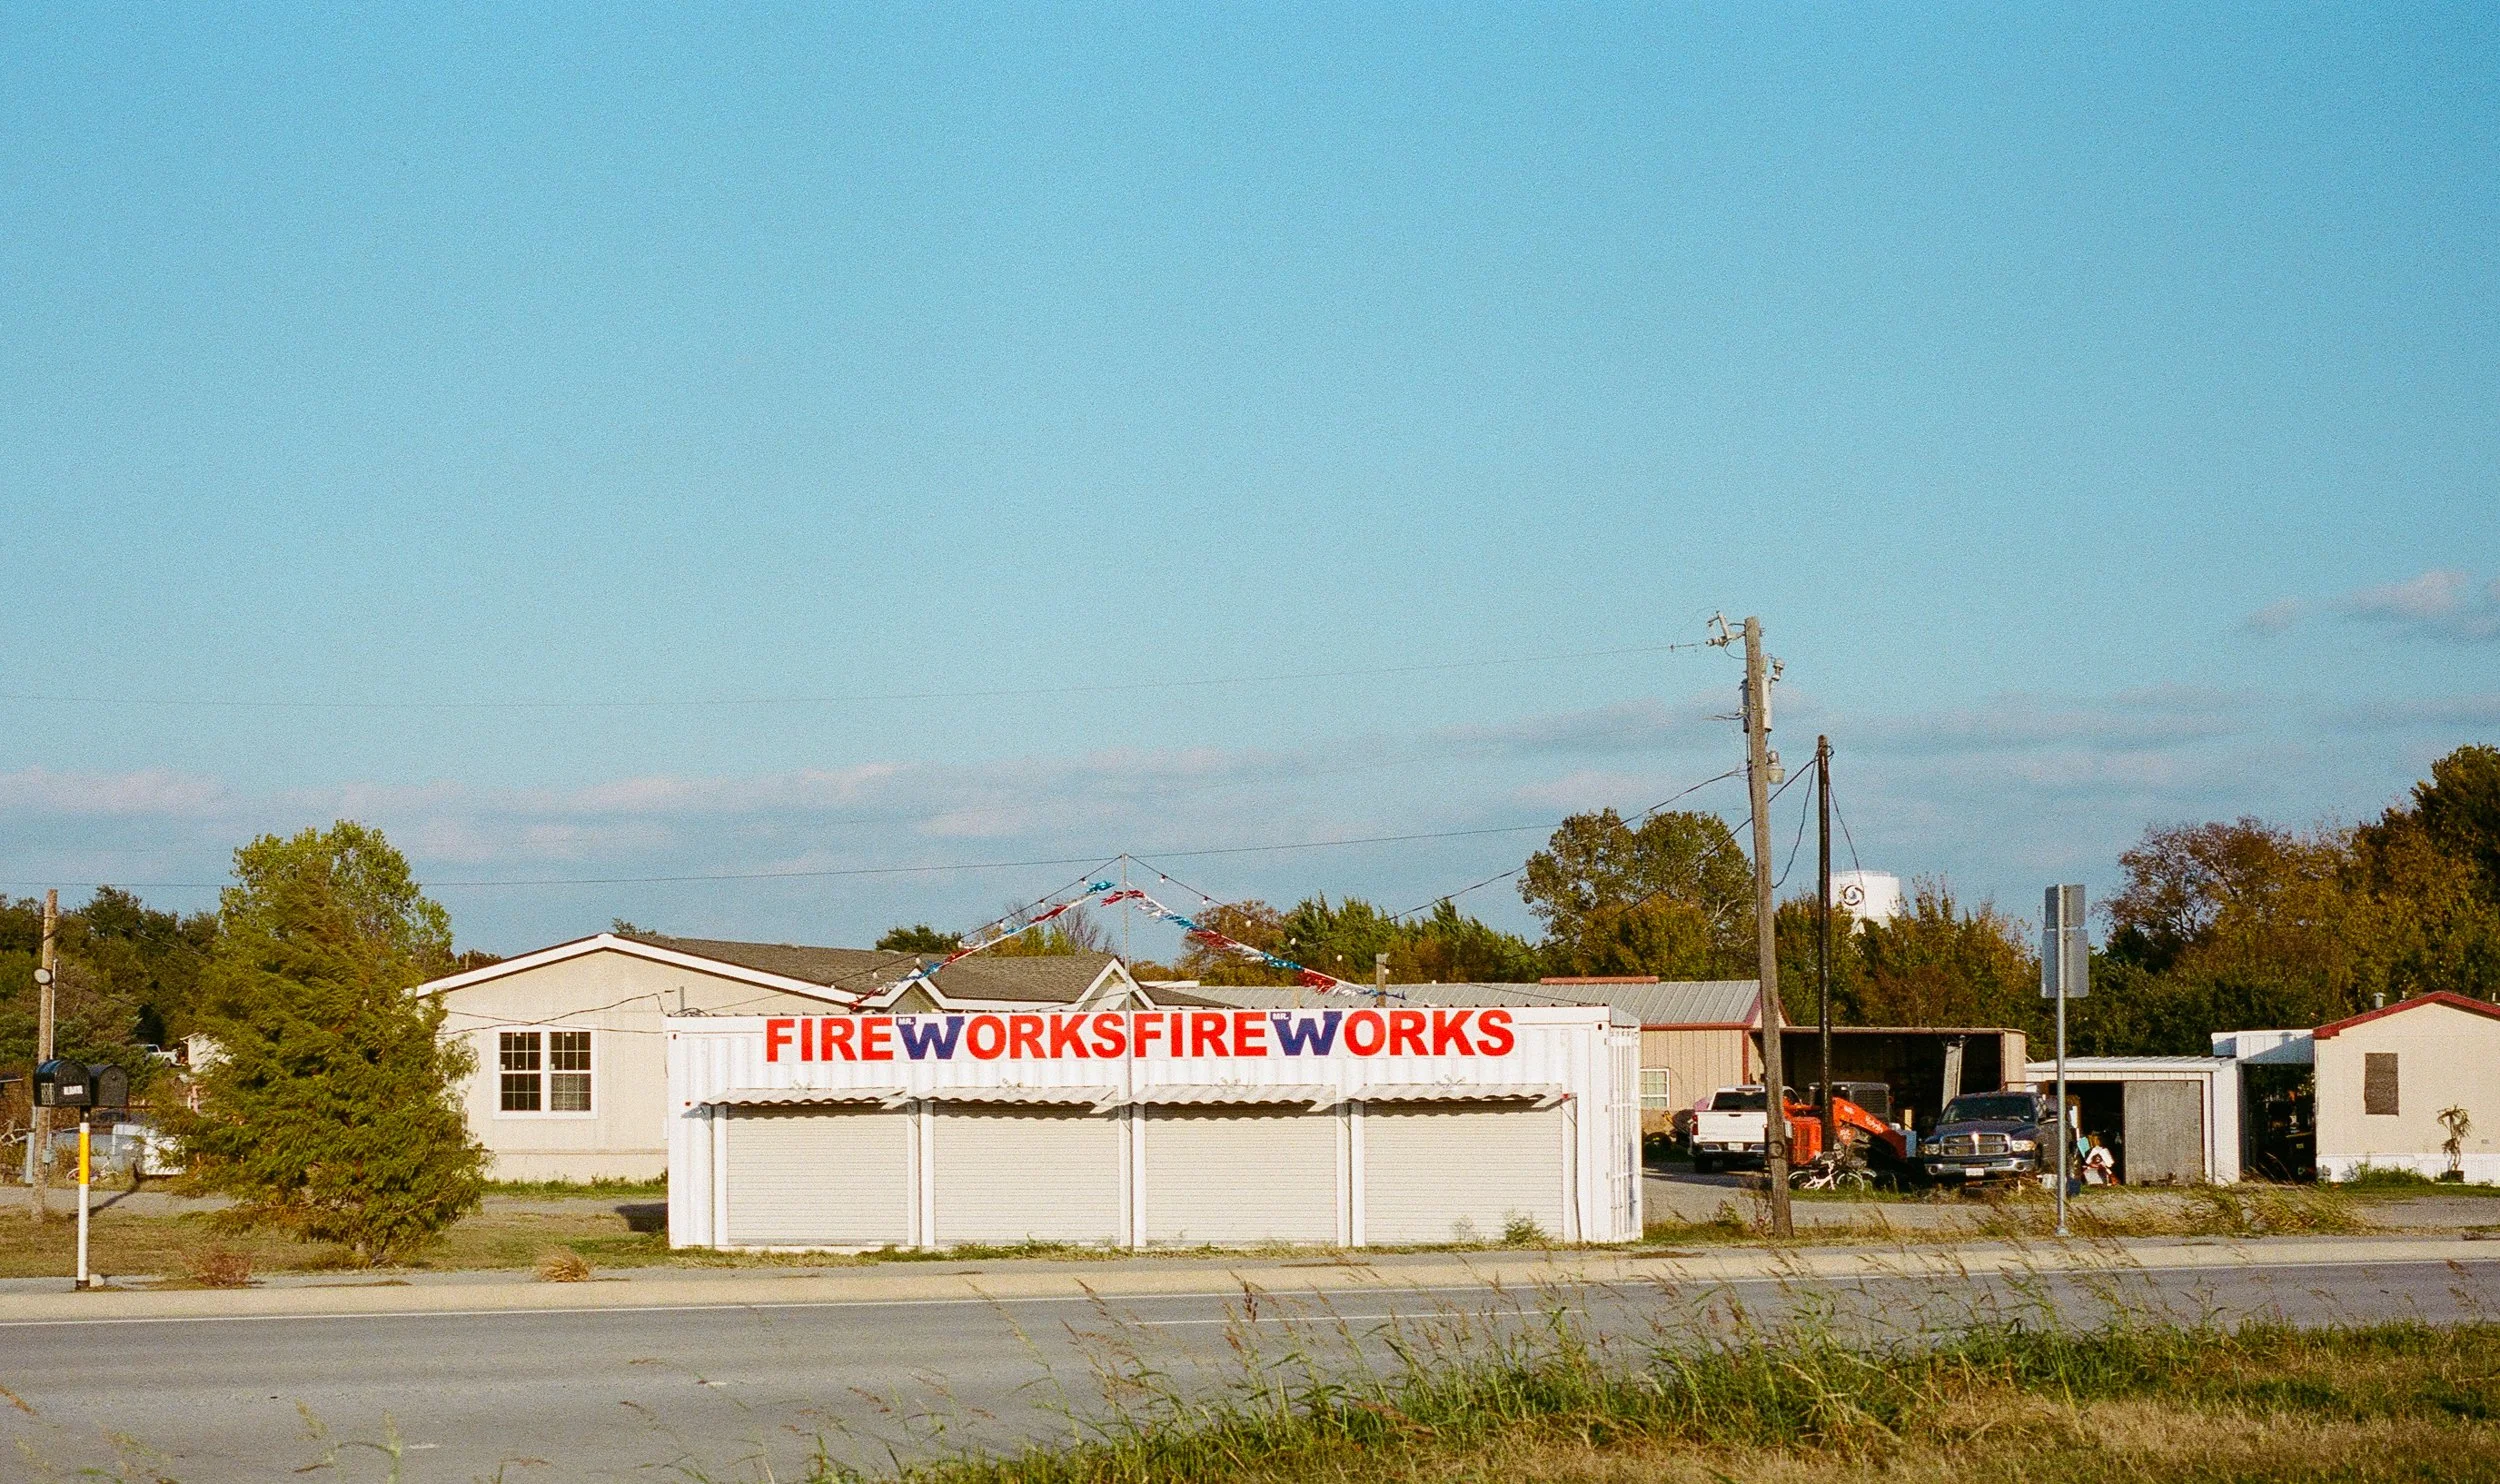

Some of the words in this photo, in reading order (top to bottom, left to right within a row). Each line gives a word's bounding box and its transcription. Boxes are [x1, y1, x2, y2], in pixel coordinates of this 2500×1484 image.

[1272, 1012, 1289, 1020] MR.
[897, 1017, 915, 1026] MR.
[767, 1014, 1127, 1062] FIREWORKS
[1133, 1010, 1515, 1058] FIREWORKS
